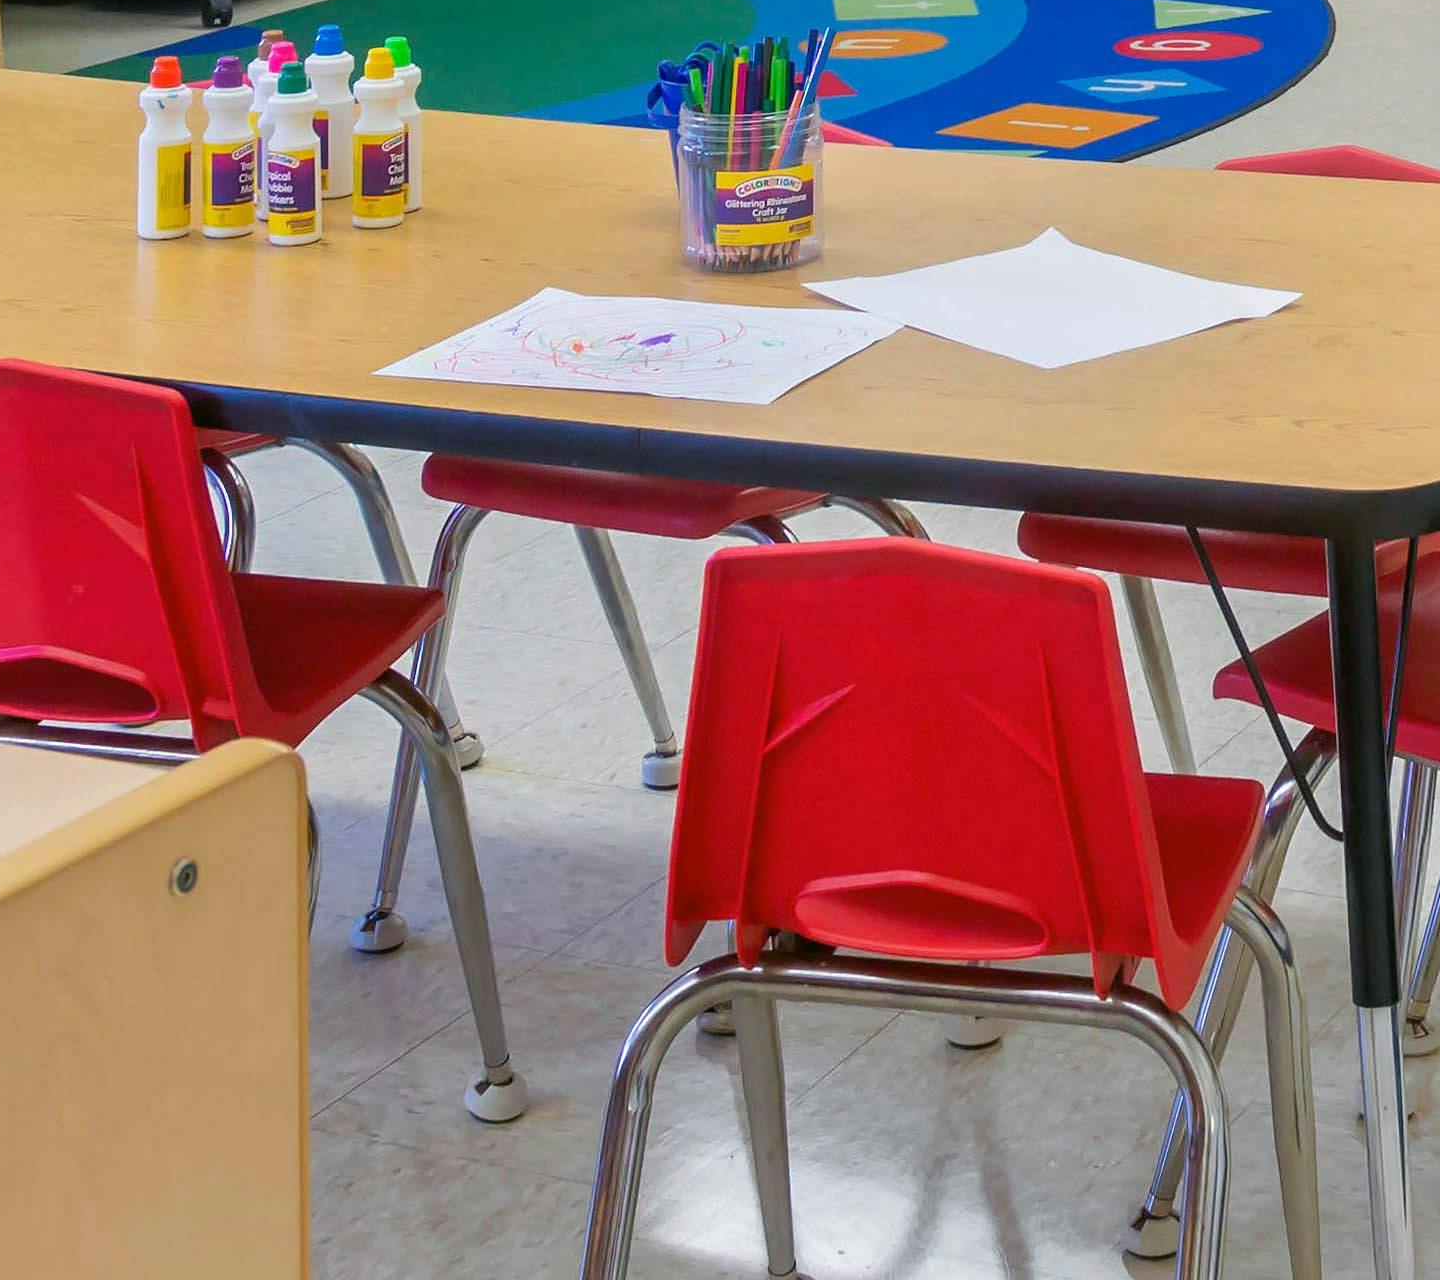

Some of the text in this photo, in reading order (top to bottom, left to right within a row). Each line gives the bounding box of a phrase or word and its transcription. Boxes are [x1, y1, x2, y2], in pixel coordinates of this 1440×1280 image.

[725, 199, 765, 209] Glittering
[752, 207, 788, 217] Craft Jar
